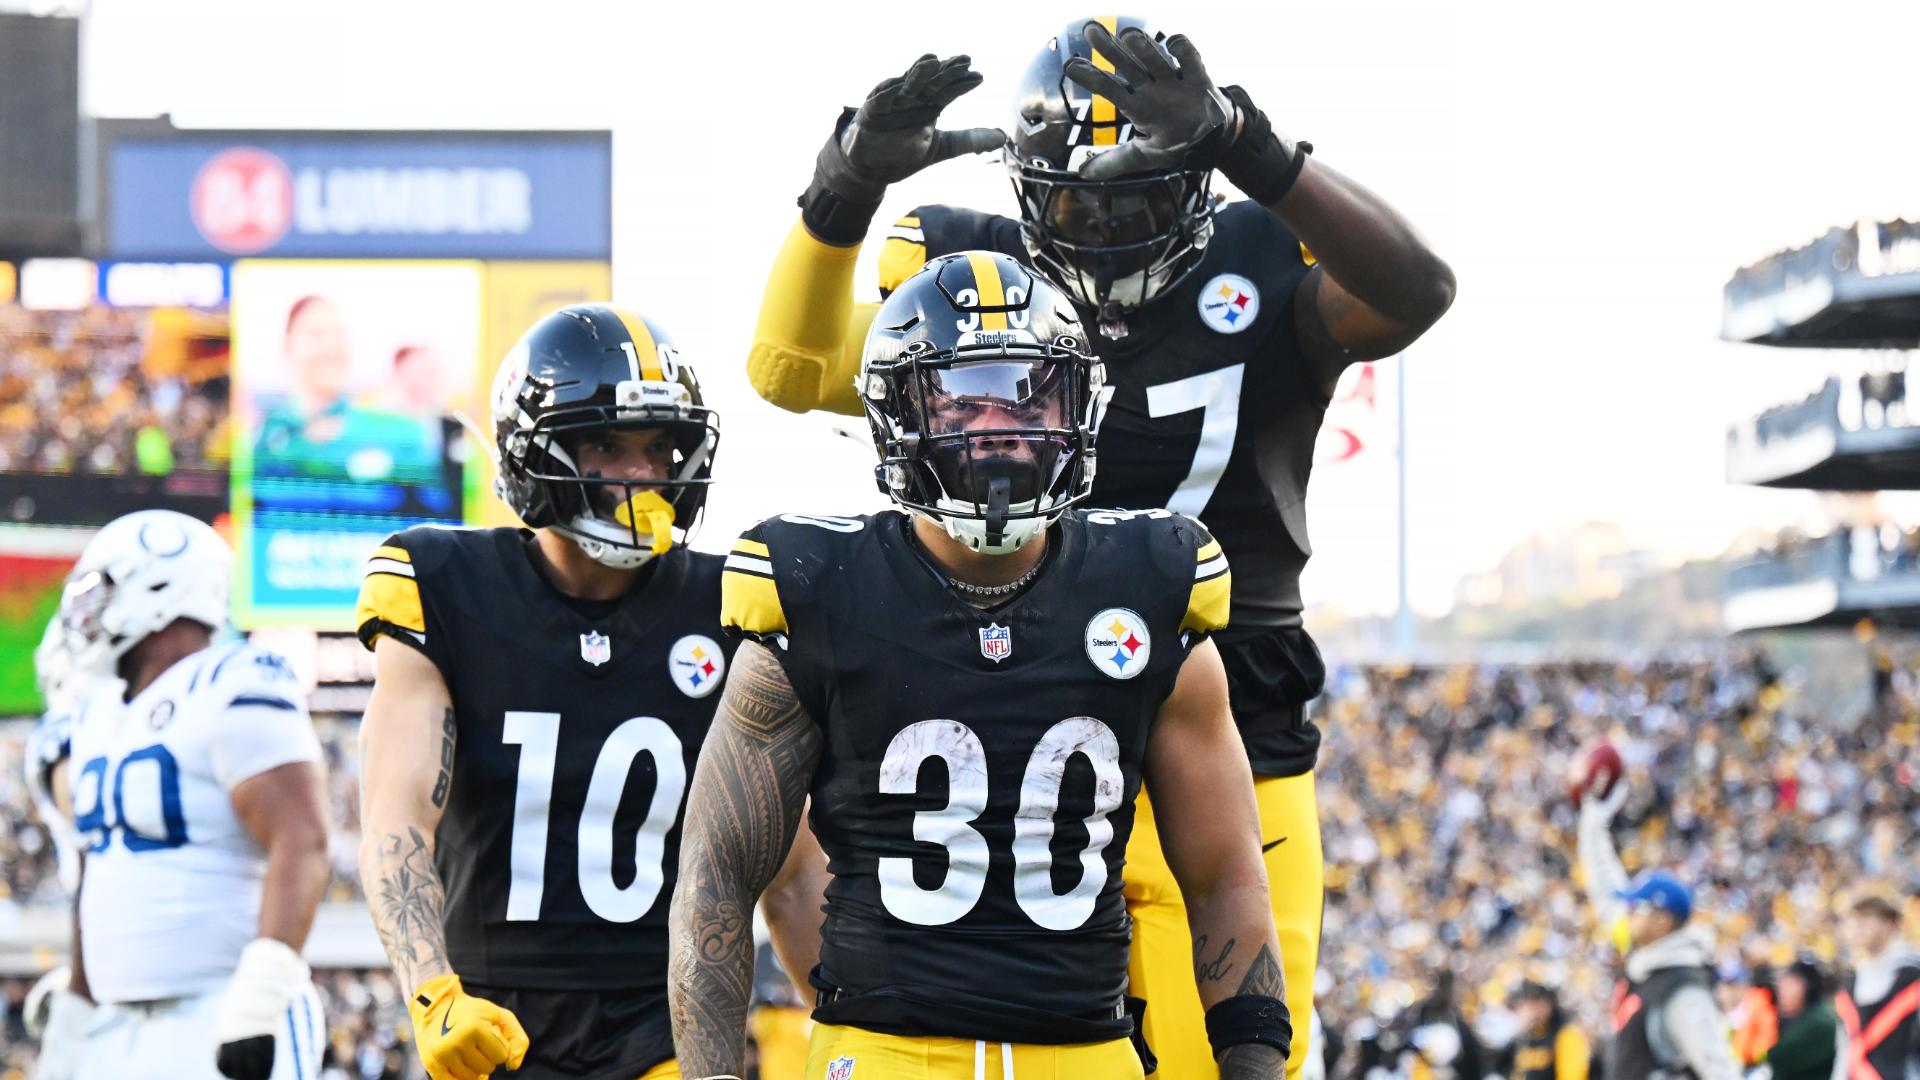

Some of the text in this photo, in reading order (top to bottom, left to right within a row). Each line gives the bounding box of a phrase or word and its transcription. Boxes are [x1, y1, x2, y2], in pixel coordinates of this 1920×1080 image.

[956, 286, 1029, 332] 30
[974, 331, 1017, 345] Steelers
[620, 342, 680, 382] 10
[986, 640, 1007, 655] NFL
[1092, 638, 1118, 647] Steelers
[75, 743, 189, 853] 90
[502, 711, 687, 923] 10
[878, 716, 1124, 931] 30
